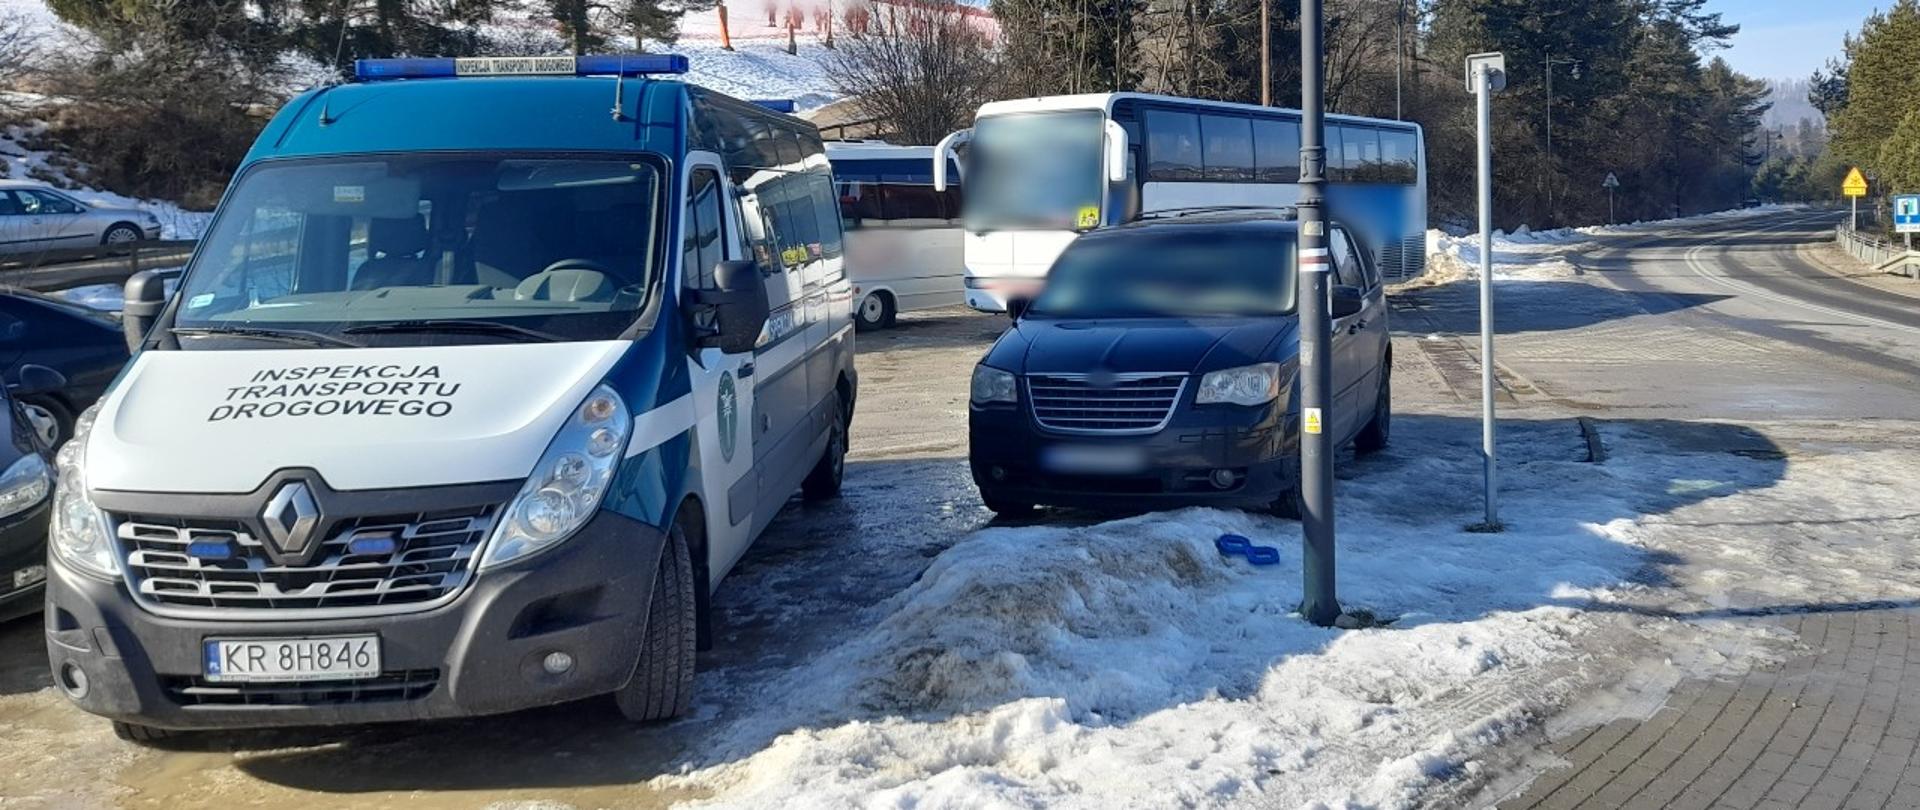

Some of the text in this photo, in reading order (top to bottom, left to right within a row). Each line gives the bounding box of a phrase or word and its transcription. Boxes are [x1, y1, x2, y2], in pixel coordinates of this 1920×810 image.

[458, 58, 574, 73] INSPEKCJA TRANSPORTU DROGOWEGO
[251, 365, 441, 382] INSPEKCJA
[225, 382, 461, 401] TRANSPORTU
[207, 399, 453, 422] DROGOWEGO
[225, 641, 371, 672] KR 8H846
